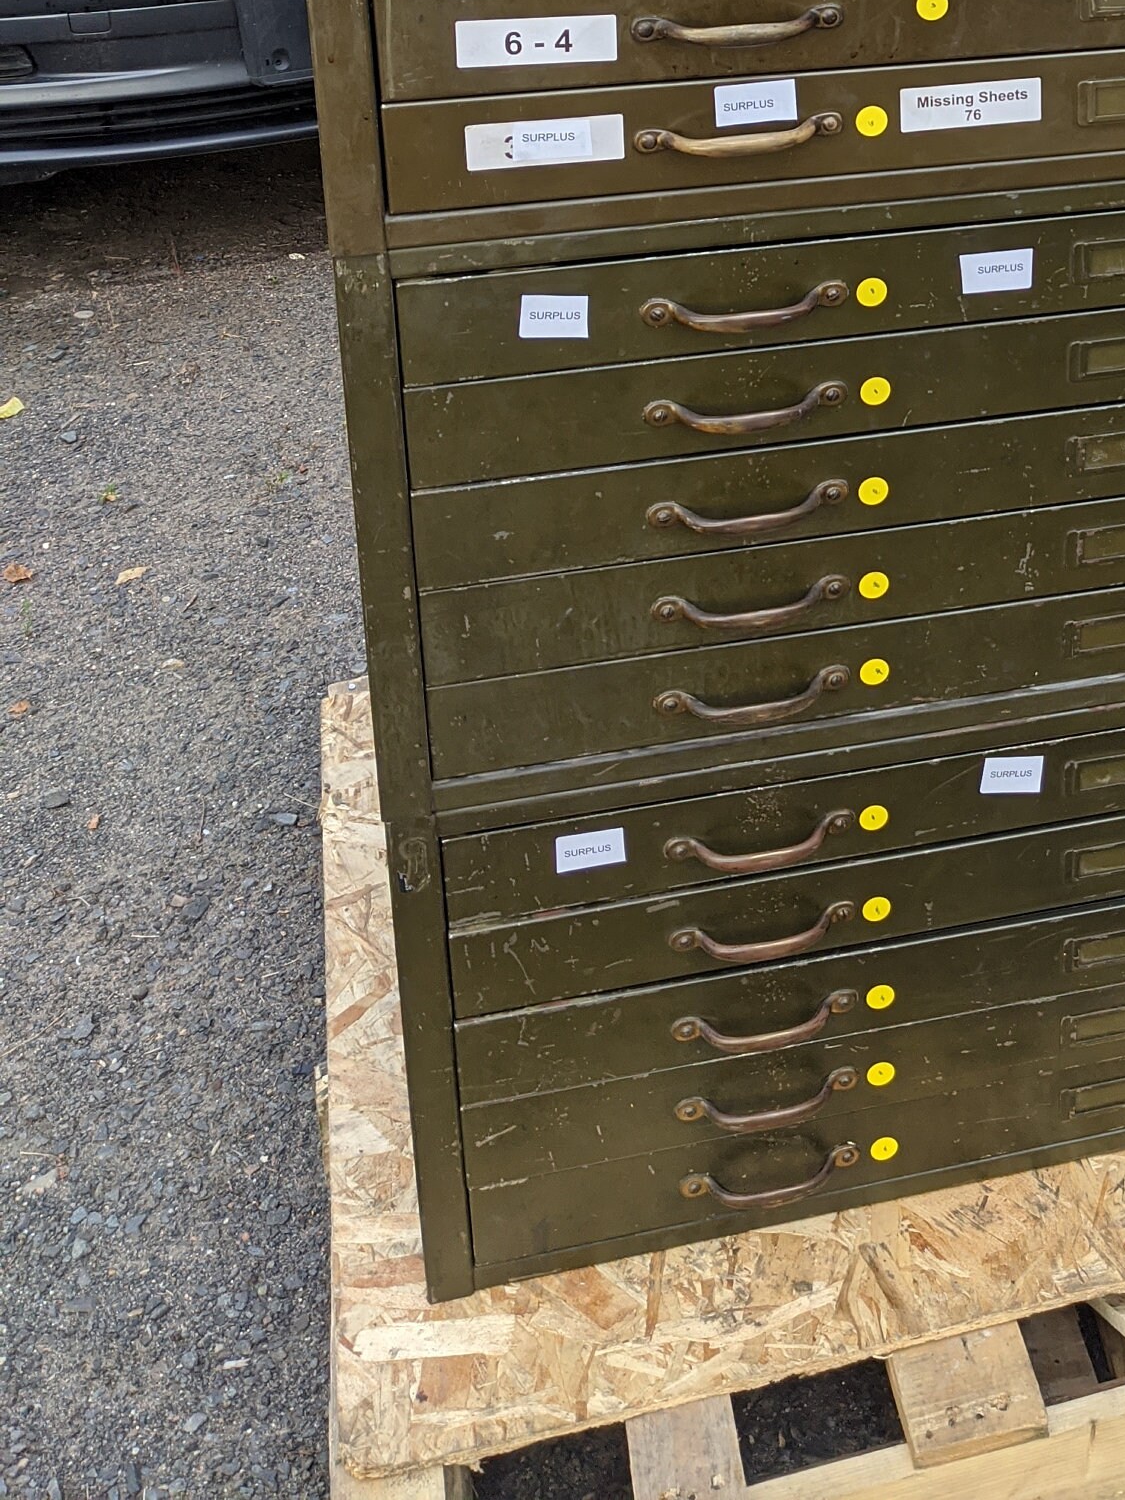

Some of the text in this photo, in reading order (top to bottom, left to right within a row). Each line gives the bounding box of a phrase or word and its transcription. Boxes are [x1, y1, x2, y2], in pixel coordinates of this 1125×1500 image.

[504, 31, 522, 55] 6
[554, 29, 573, 53] 4
[723, 98, 774, 113] SURPLUS
[917, 88, 1029, 111] Missing Sheets
[964, 107, 982, 121] 76
[522, 132, 575, 143] SURPLUS
[977, 262, 1024, 274] SURPLUS
[528, 310, 581, 320] SURPLUS
[989, 769, 1033, 778] SURPLUS
[563, 843, 612, 858] SURPLUS
